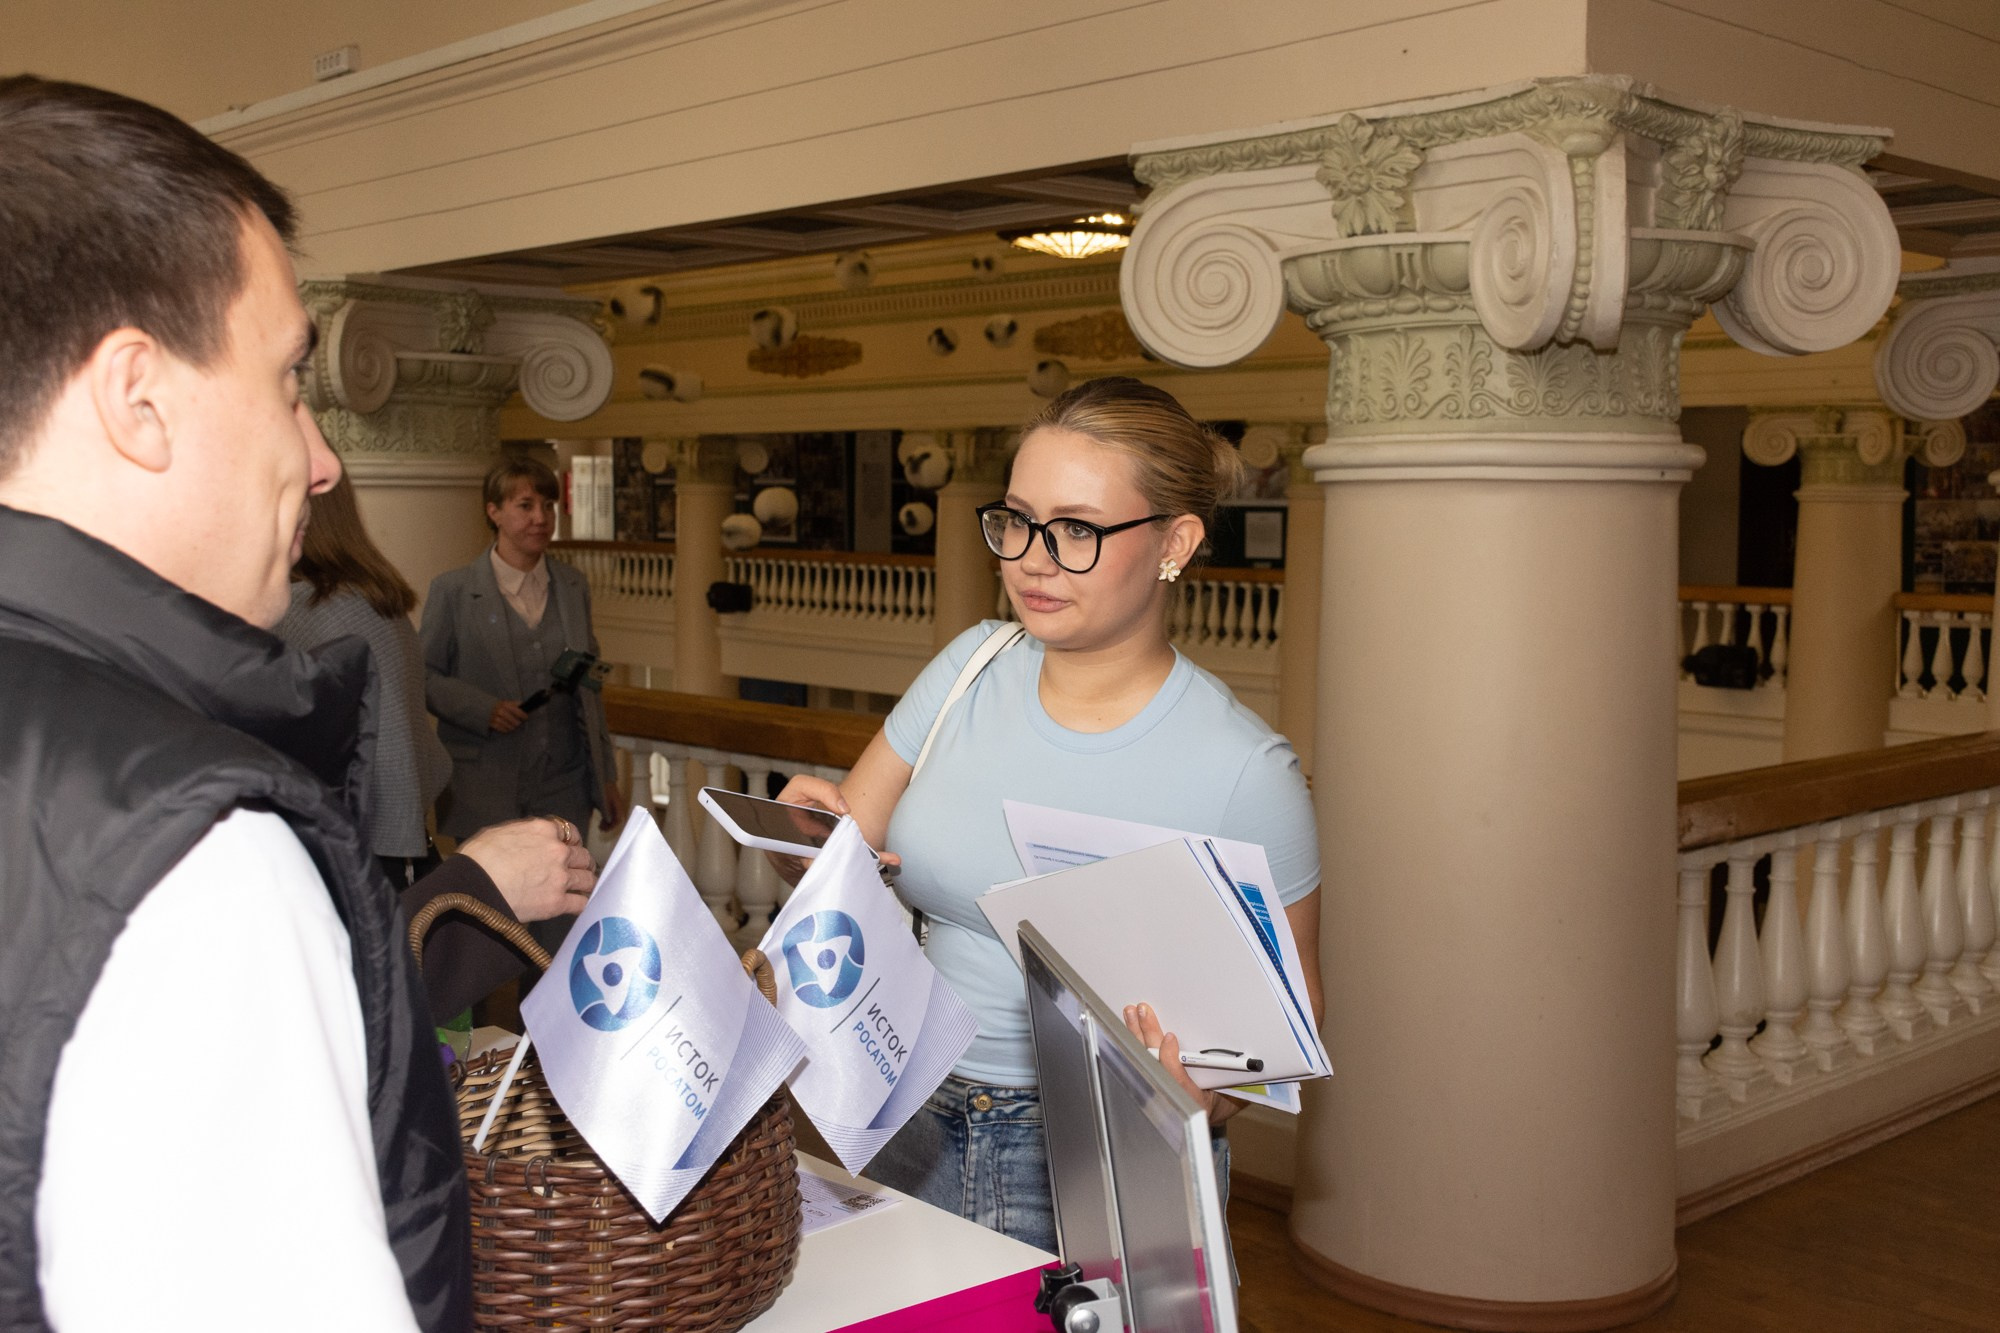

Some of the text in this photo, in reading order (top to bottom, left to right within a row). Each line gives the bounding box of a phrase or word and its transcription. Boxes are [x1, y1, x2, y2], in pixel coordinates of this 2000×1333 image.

[666, 1026, 719, 1092] ИСТОК
[852, 1020, 898, 1087] РОСАТОМ
[867, 1003, 907, 1062] ИСТОК
[646, 1045, 708, 1120] РОСАТОМ
